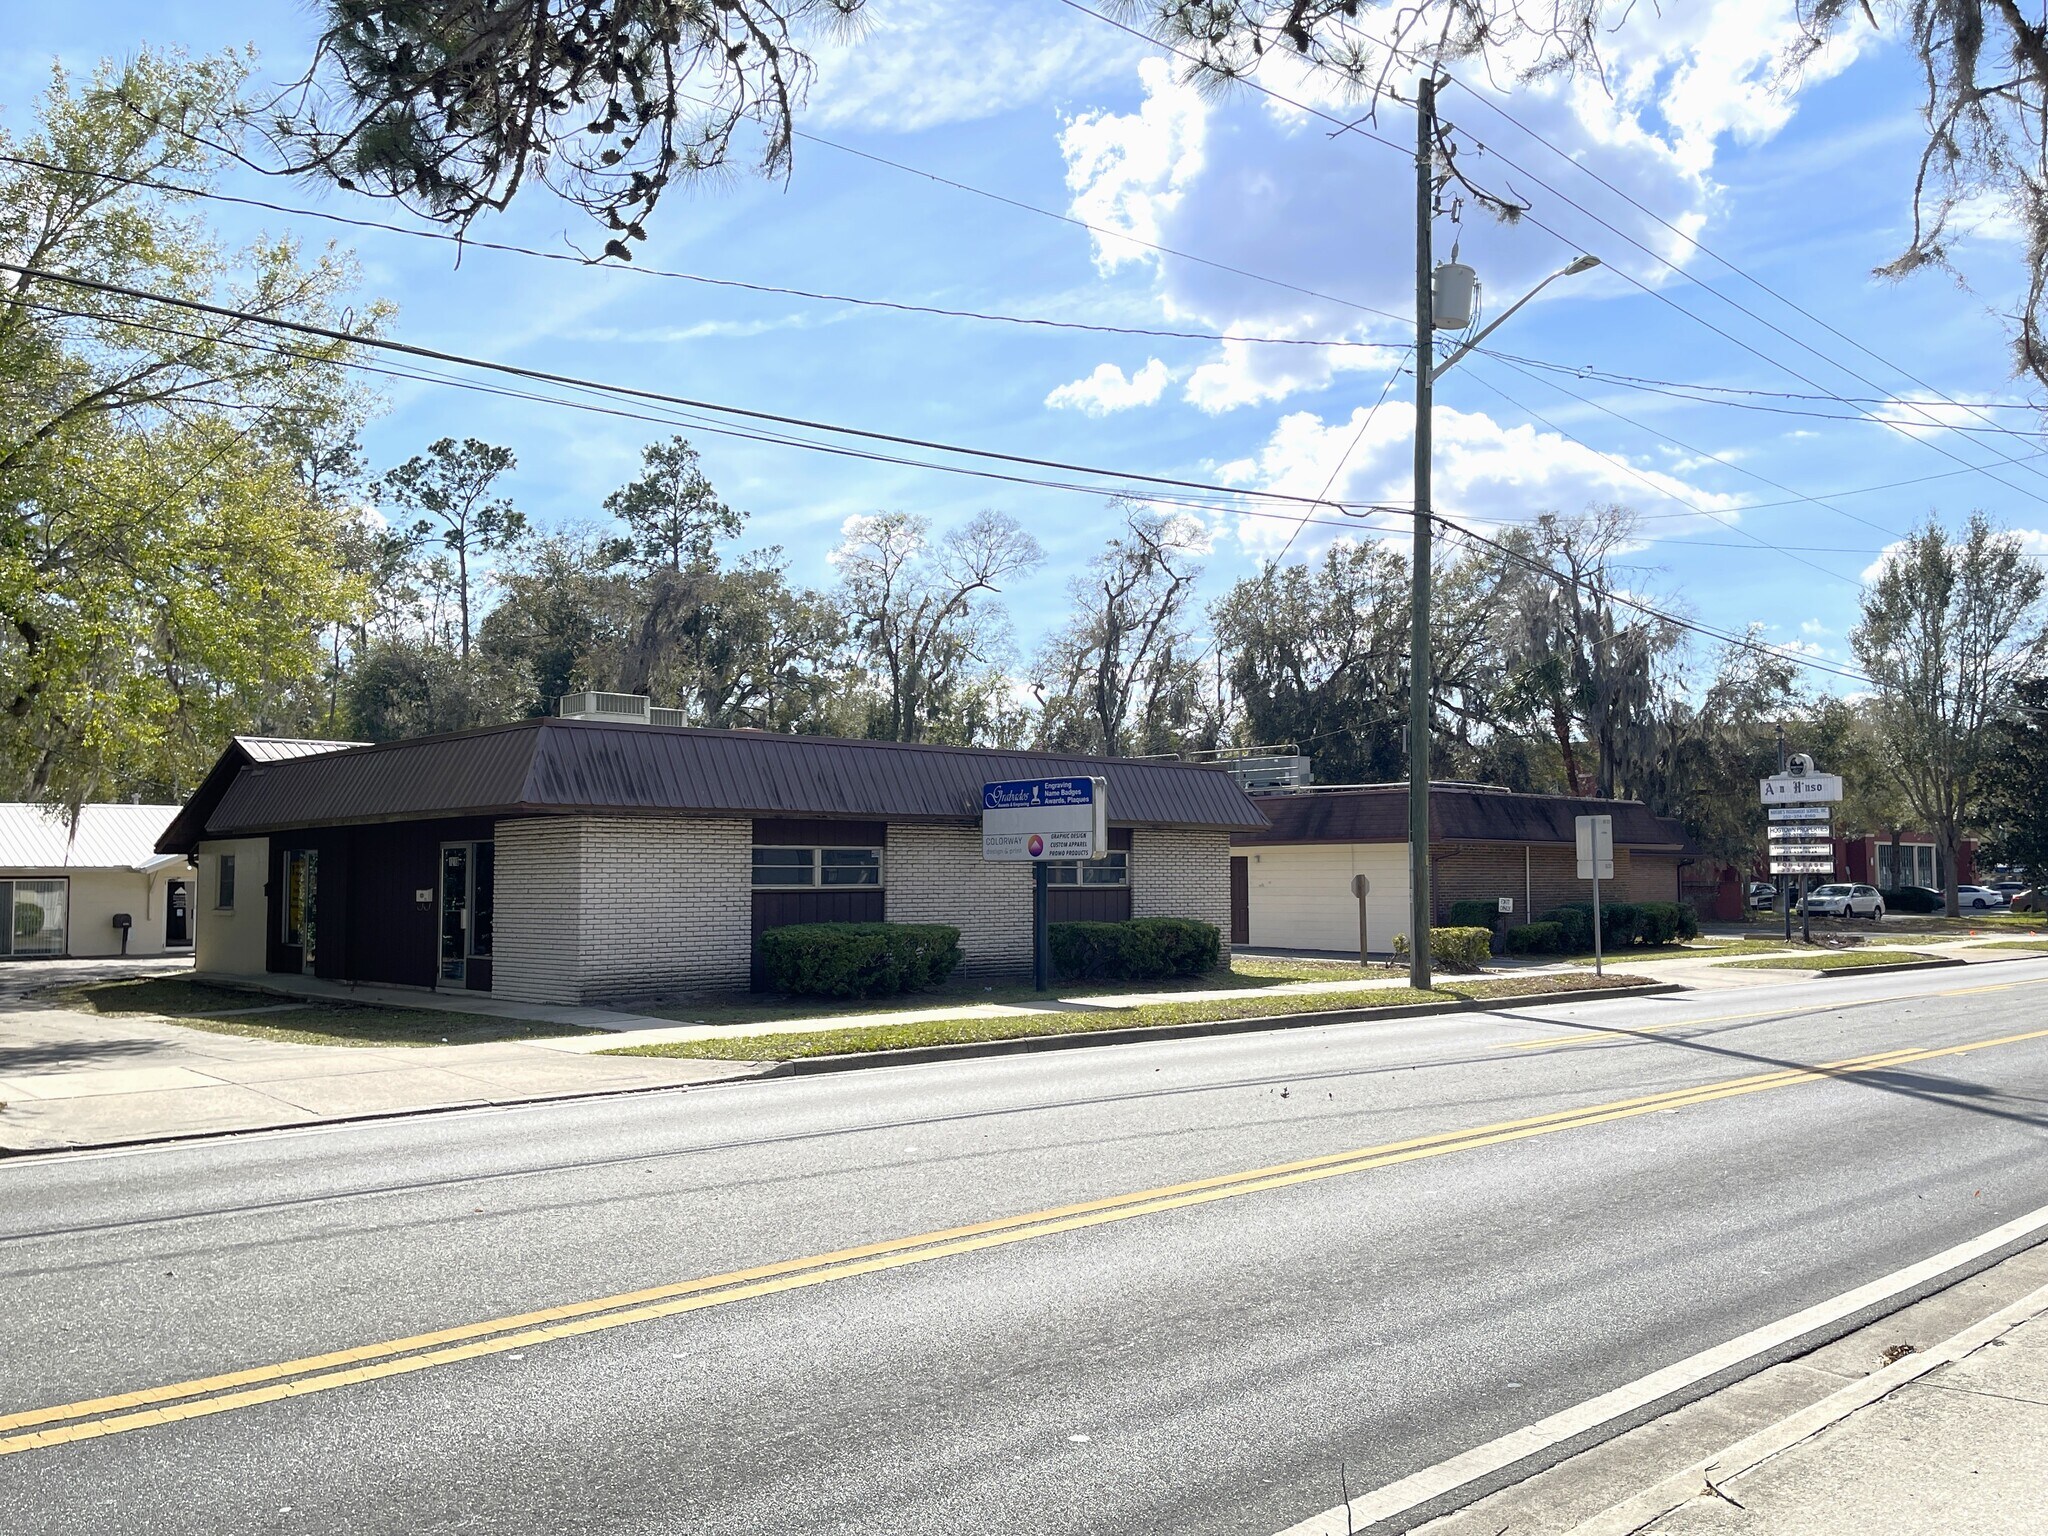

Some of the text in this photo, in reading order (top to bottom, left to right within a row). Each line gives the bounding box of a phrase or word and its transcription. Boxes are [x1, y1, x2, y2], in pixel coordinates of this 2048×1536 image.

[1044, 782, 1072, 790] Engraving
[1060, 789, 1081, 797] Badges
[1067, 796, 1090, 804] Plaques
[986, 837, 1023, 845] COLORWAY
[986, 848, 1003, 856] design
[1009, 847, 1022, 855] print
